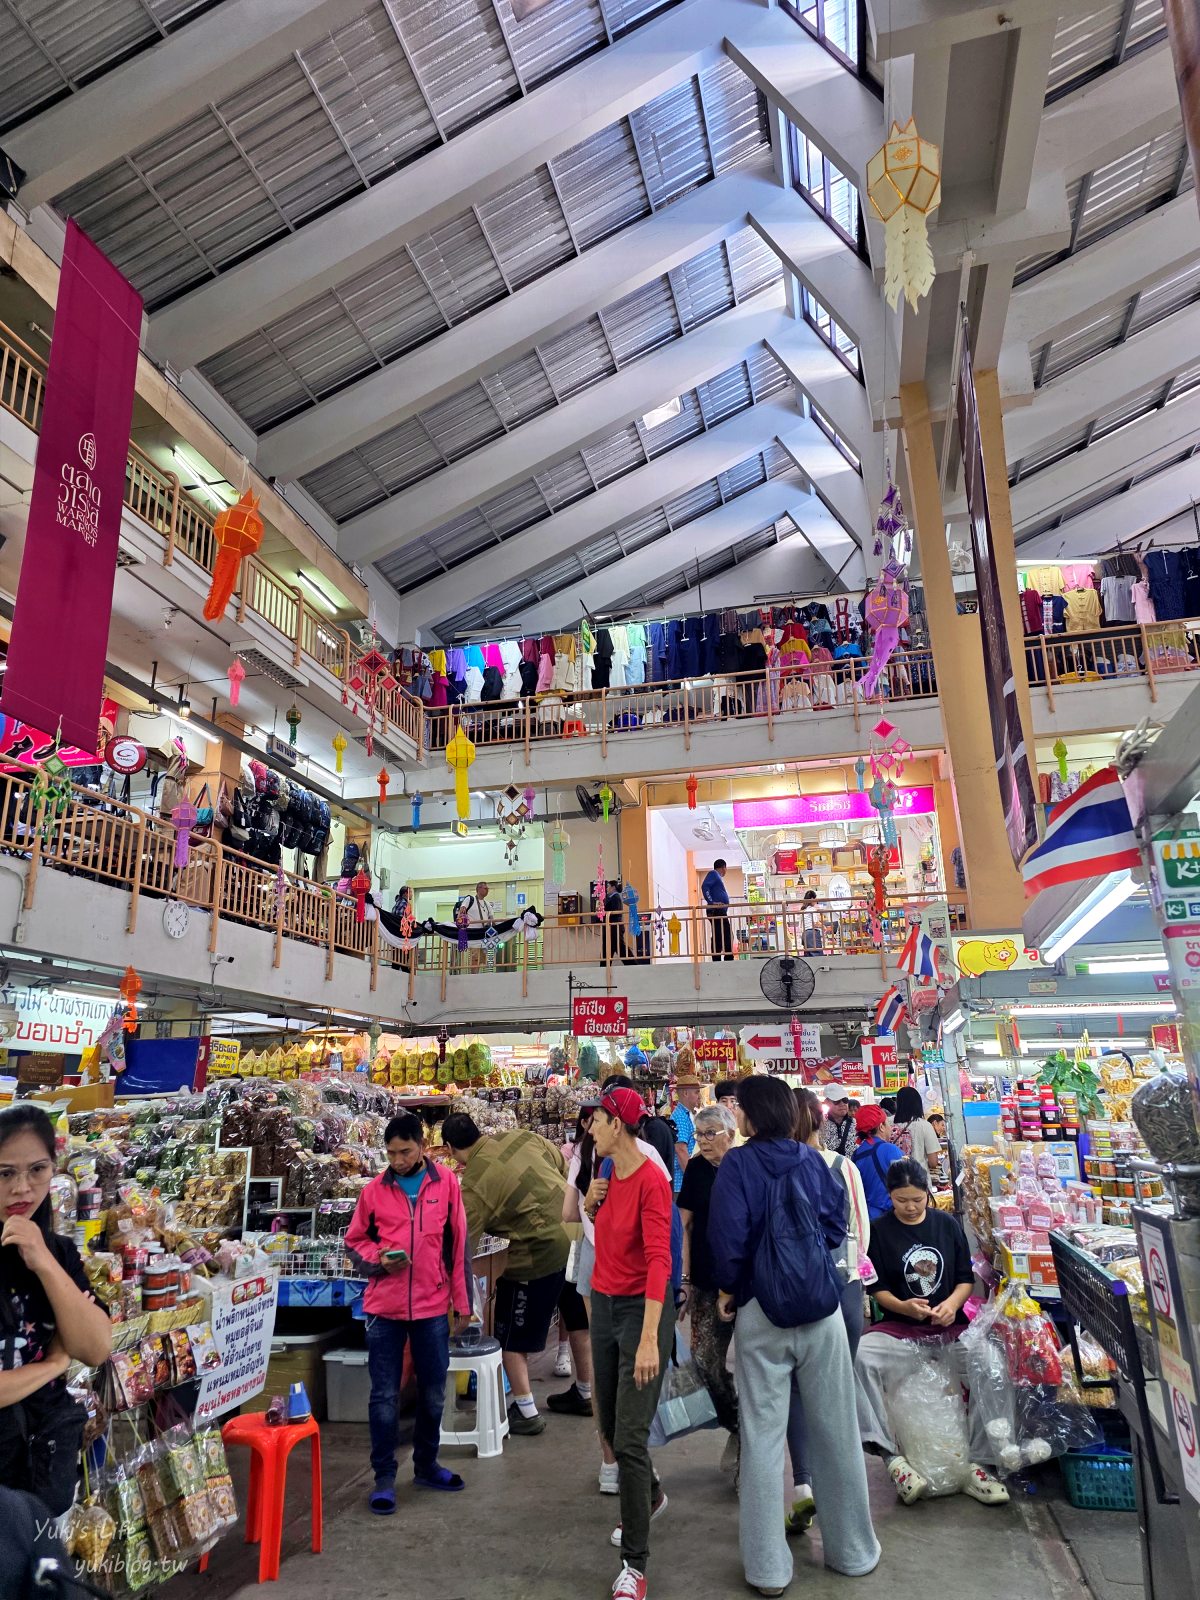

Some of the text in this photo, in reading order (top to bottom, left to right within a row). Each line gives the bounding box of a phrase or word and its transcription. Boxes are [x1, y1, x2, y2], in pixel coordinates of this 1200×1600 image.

[61, 463, 101, 507] ตลาด
[16, 1020, 93, 1046] ของชำ
[514, 1290, 528, 1327] GASP
